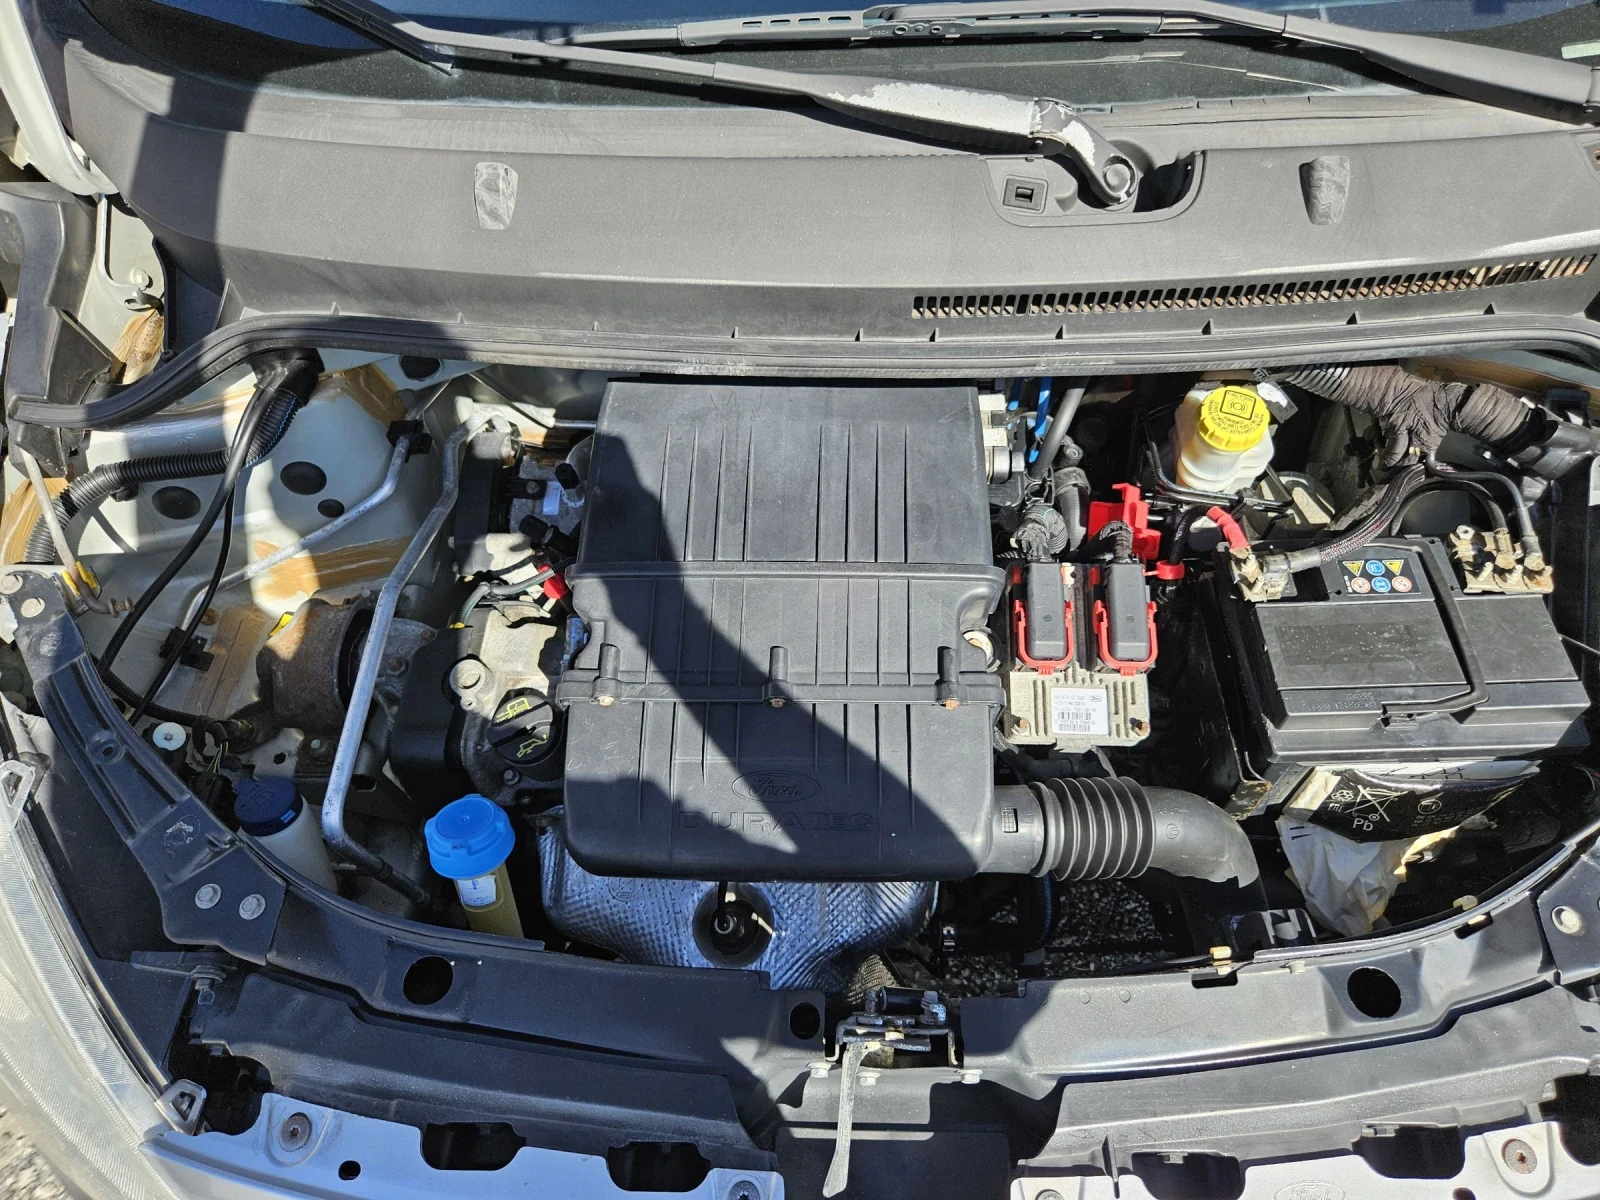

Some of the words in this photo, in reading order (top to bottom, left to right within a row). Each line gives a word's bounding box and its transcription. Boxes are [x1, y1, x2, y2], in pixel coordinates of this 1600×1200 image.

[749, 775, 801, 798] Ford
[677, 811, 874, 832] DURATEC
[1352, 817, 1373, 831] Pb
